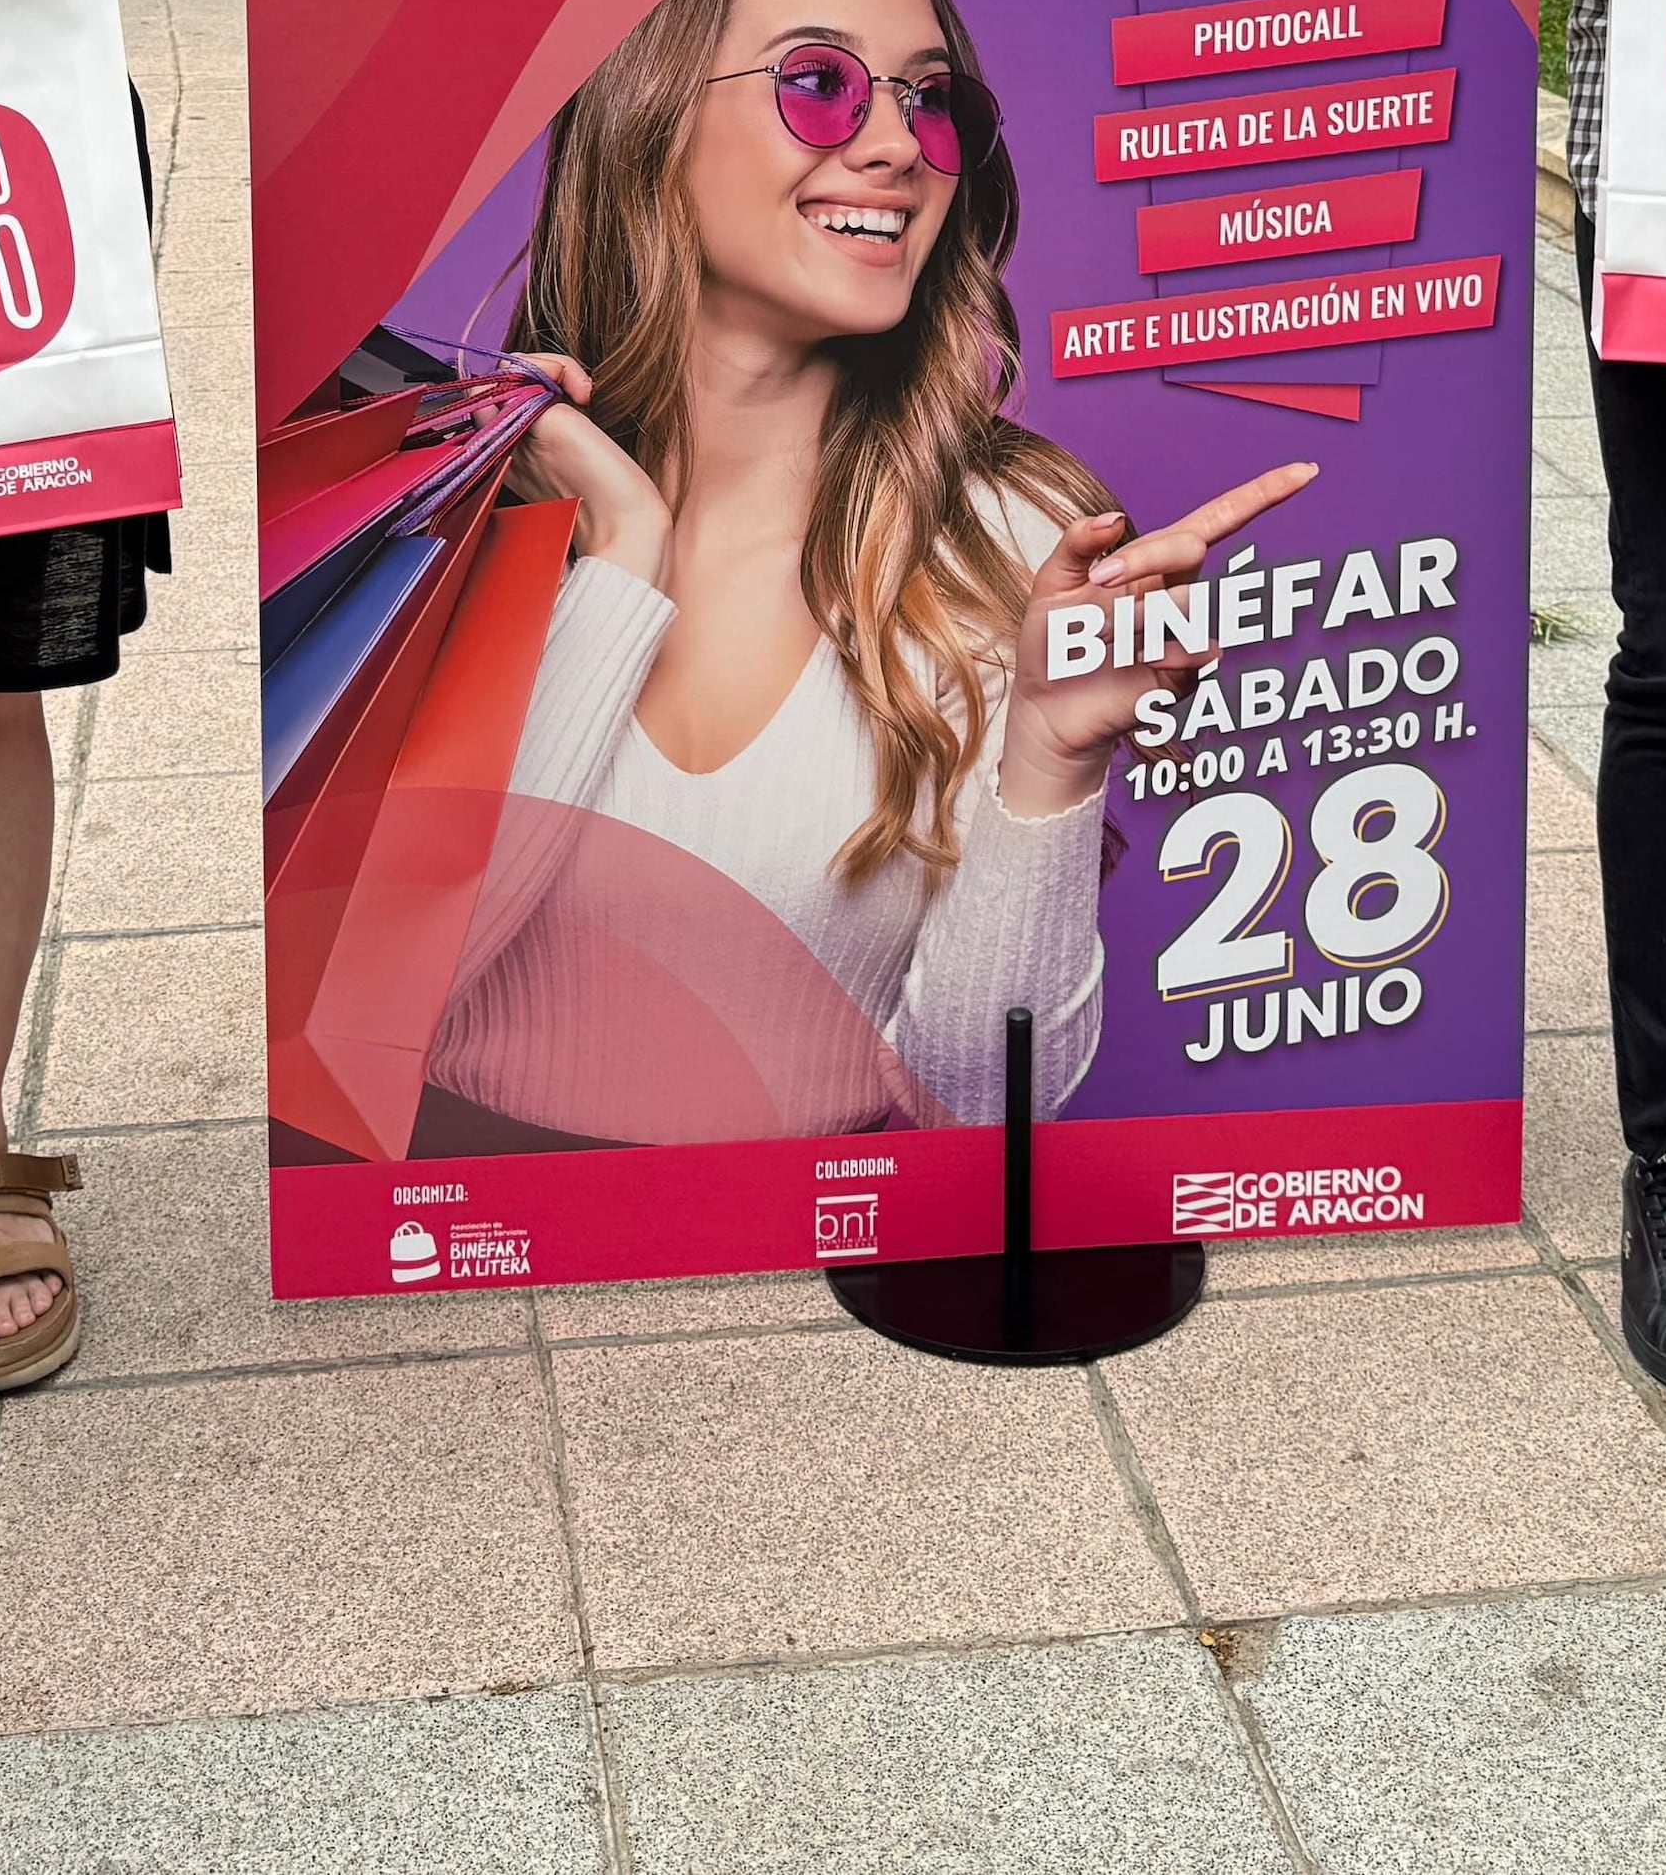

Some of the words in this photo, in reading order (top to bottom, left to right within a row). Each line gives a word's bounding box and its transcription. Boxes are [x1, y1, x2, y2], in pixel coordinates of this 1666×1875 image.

[1193, 4, 1364, 57] PHOTOCALL
[1119, 117, 1228, 162] RULETA
[1238, 113, 1275, 148] DE
[1283, 107, 1318, 143] LA
[1327, 91, 1434, 137] SUERTE
[1219, 198, 1333, 247] MÚSICA
[1063, 319, 1135, 360] ARTE
[1145, 316, 1161, 349] E
[1169, 282, 1360, 348] ILUSTRACIÓN
[1370, 282, 1406, 319] EN
[1415, 273, 1483, 314] VIVO
[21, 468, 94, 494] ARAGON
[1046, 537, 1458, 682] BINÉFAR
[1133, 635, 1460, 748] SÁBADO
[1125, 745, 1245, 801] 10:00
[1257, 738, 1289, 777] A
[1302, 711, 1420, 767] 13:30
[1433, 701, 1477, 745] H.
[1157, 763, 1450, 1003] 28
[1184, 967, 1423, 1063] JUNIO
[815, 1156, 899, 1180] COLABORAN:
[1234, 1166, 1403, 1201] GOBIERNO
[393, 1184, 470, 1206] ORGANIZA:
[1234, 1201, 1277, 1229] DE
[1286, 1193, 1425, 1227] ARAGON
[815, 1201, 879, 1241] bnf
[450, 1238, 517, 1261] BINÉFAR
[520, 1238, 531, 1257] Y
[450, 1259, 472, 1279] LA
[475, 1256, 531, 1277] LITERA
